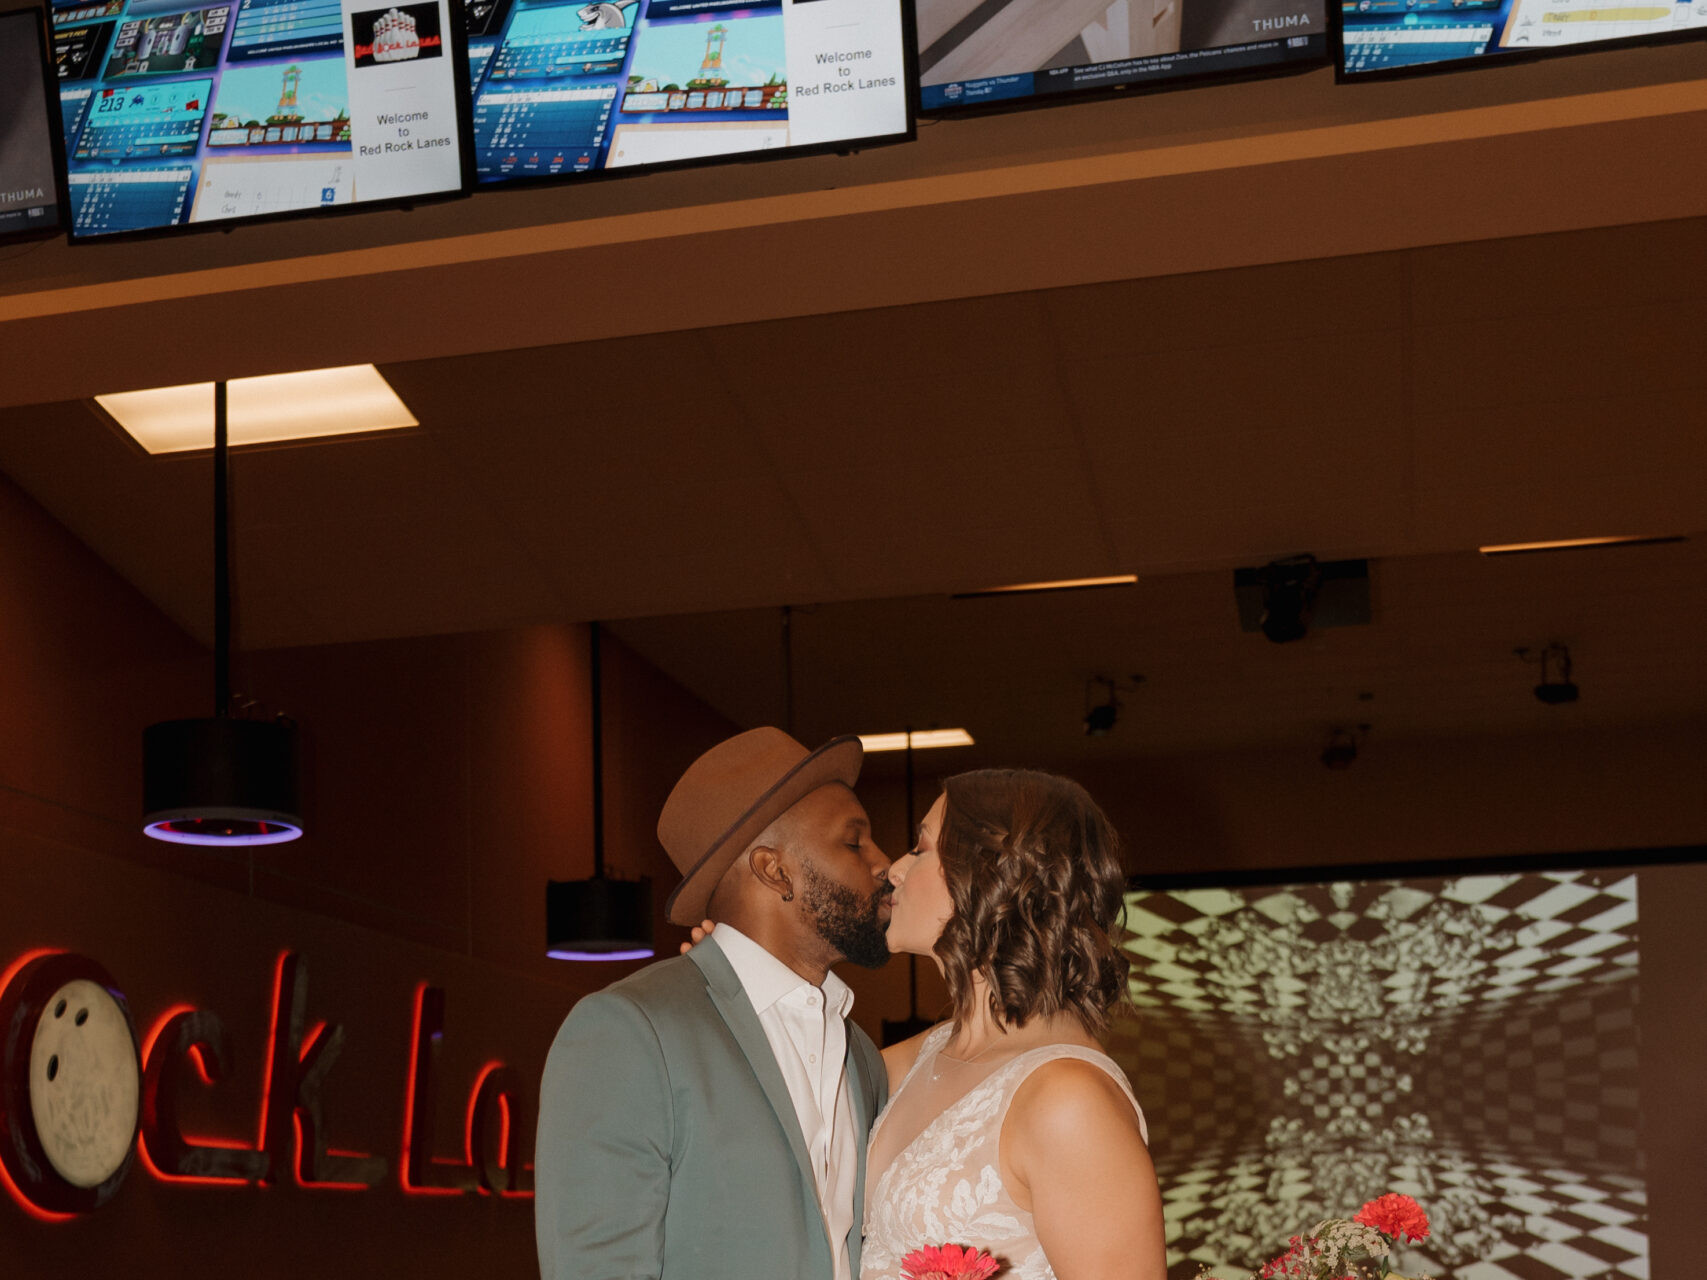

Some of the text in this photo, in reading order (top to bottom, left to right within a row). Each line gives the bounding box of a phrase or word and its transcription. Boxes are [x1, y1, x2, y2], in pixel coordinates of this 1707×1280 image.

[1252, 14, 1311, 32] THUMA
[815, 50, 872, 64] Welcome
[838, 67, 850, 77] to
[796, 77, 896, 97] Red Rock Lanes
[98, 97, 124, 113] 213
[377, 111, 429, 125] Welcome
[398, 128, 410, 137] to
[360, 137, 451, 156] Red Rock Lanes
[0, 187, 45, 203] THUMA
